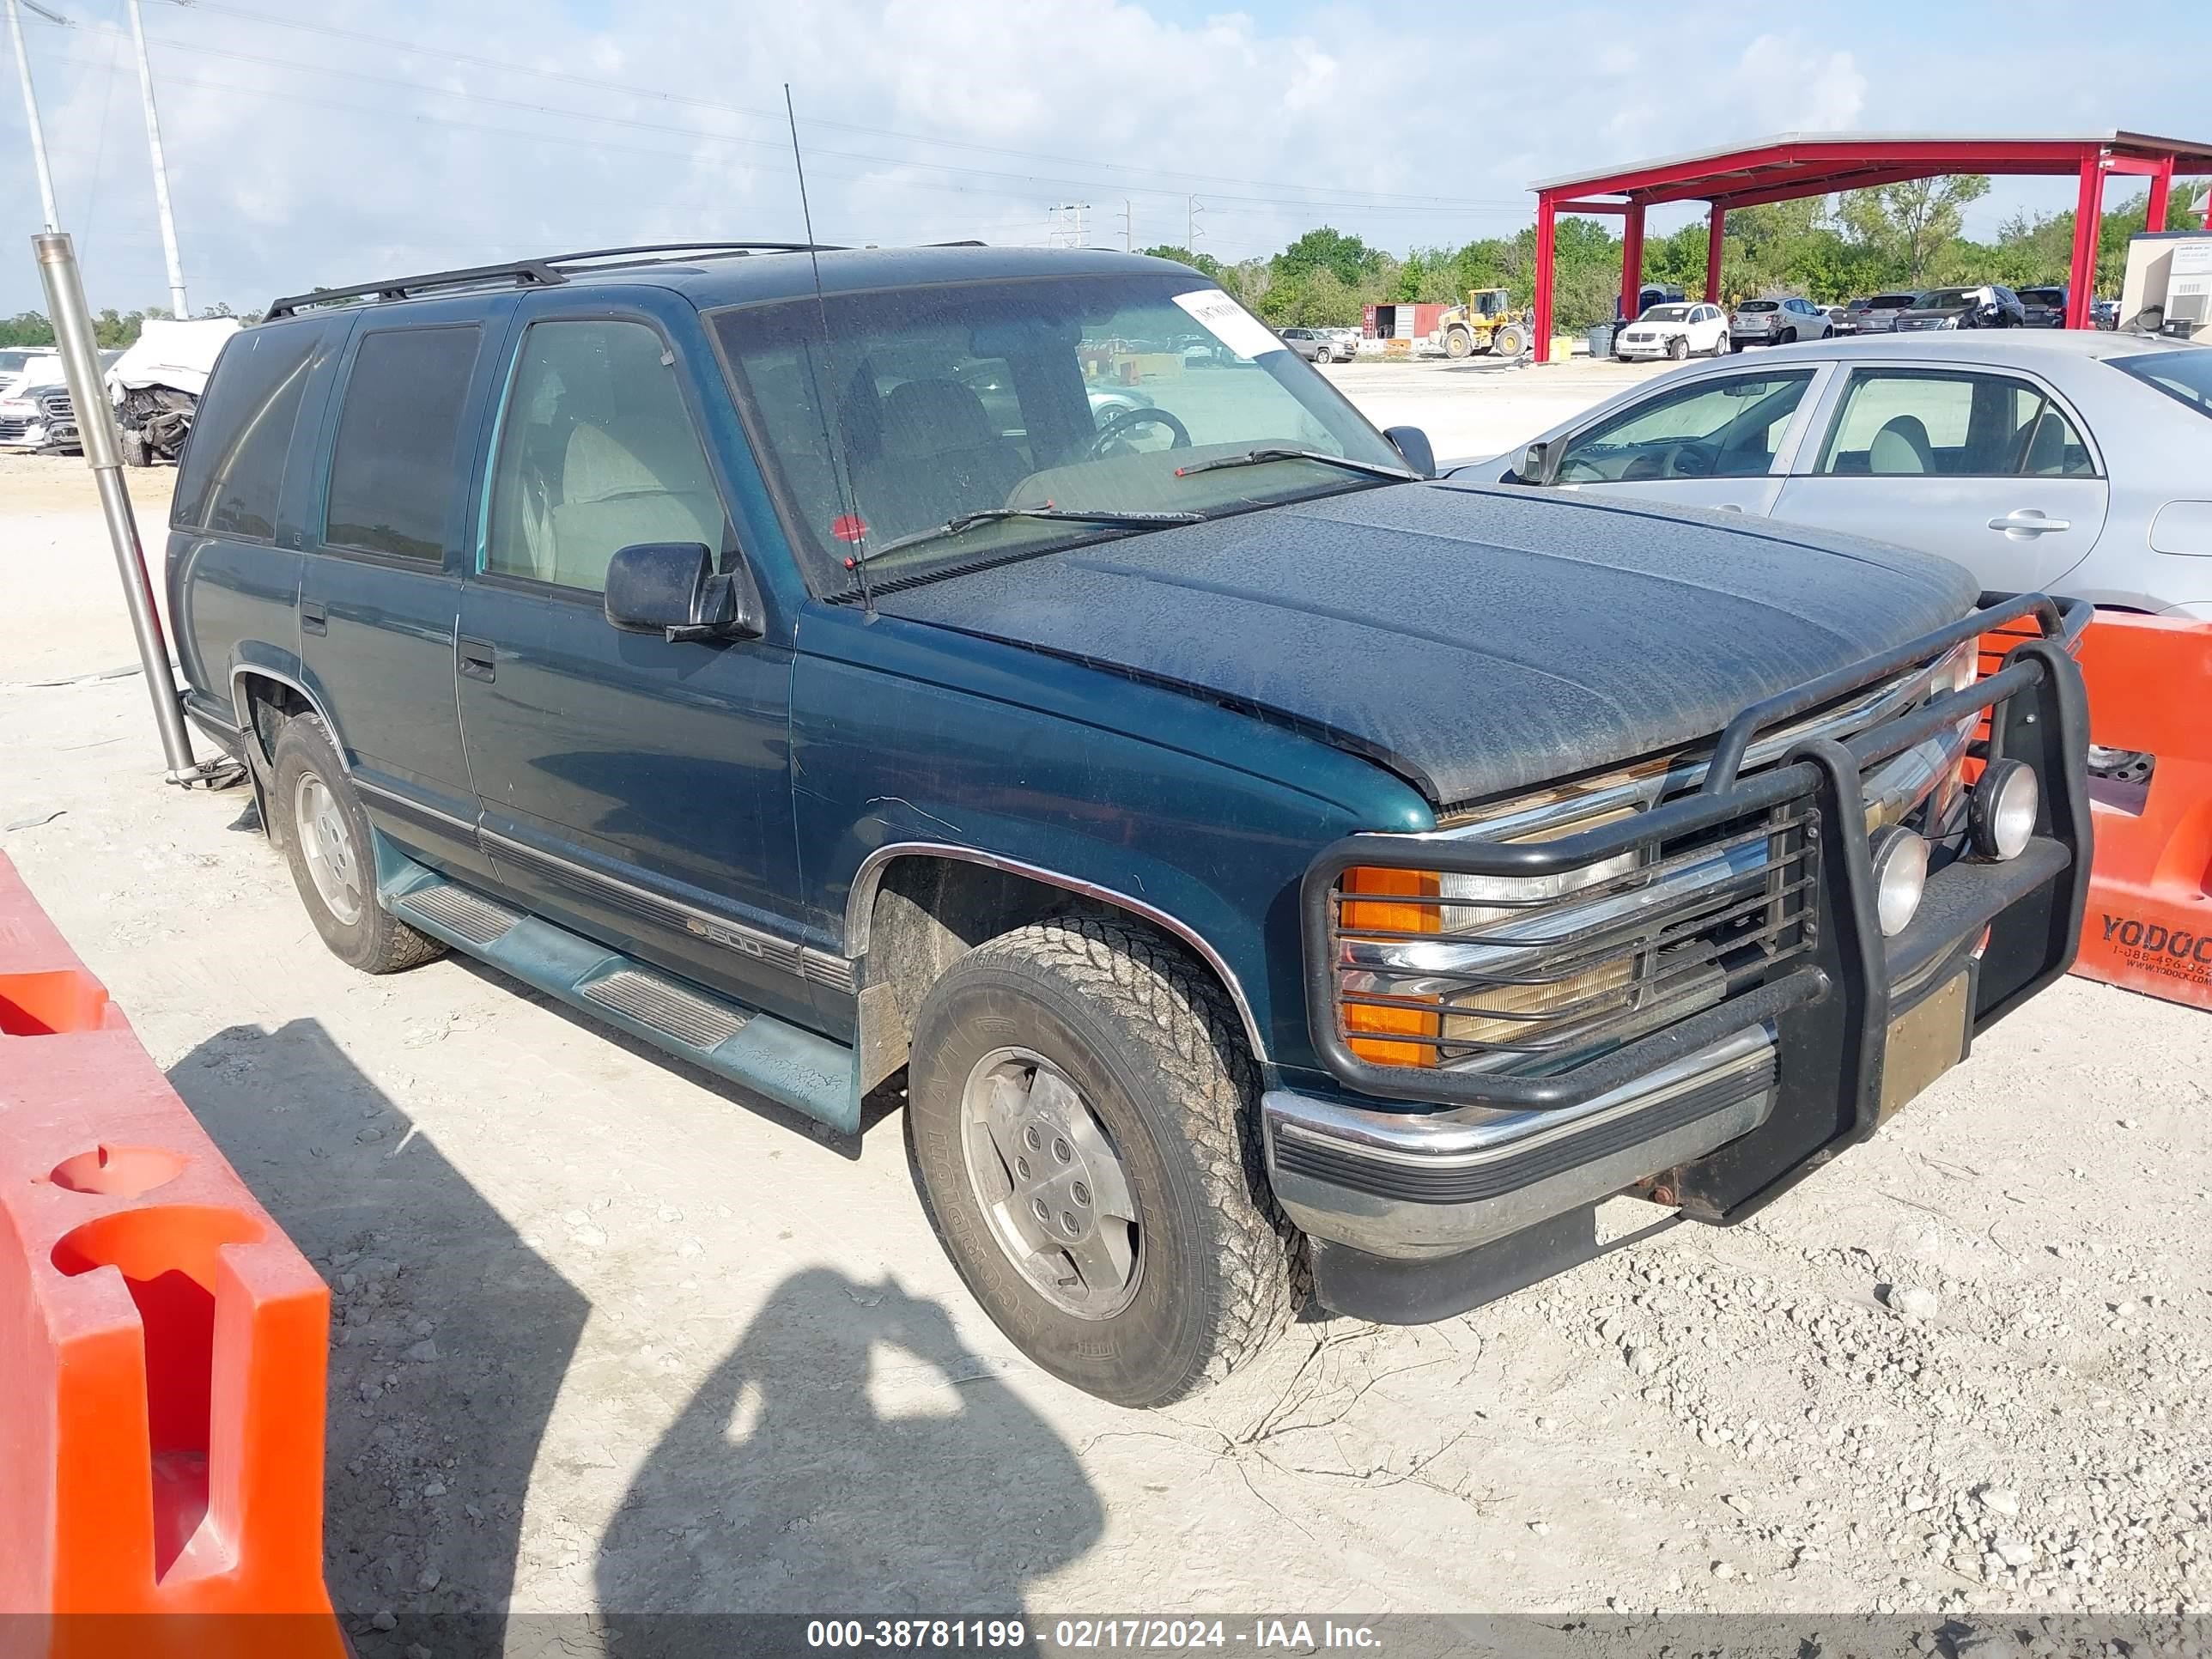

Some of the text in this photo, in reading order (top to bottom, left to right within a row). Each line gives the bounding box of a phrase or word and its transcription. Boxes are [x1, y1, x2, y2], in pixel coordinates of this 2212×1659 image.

[708, 925, 763, 957] 1500
[2125, 958, 2212, 987] WWW.YODOCK.COM
[927, 1131, 1039, 1335] SCORPION
